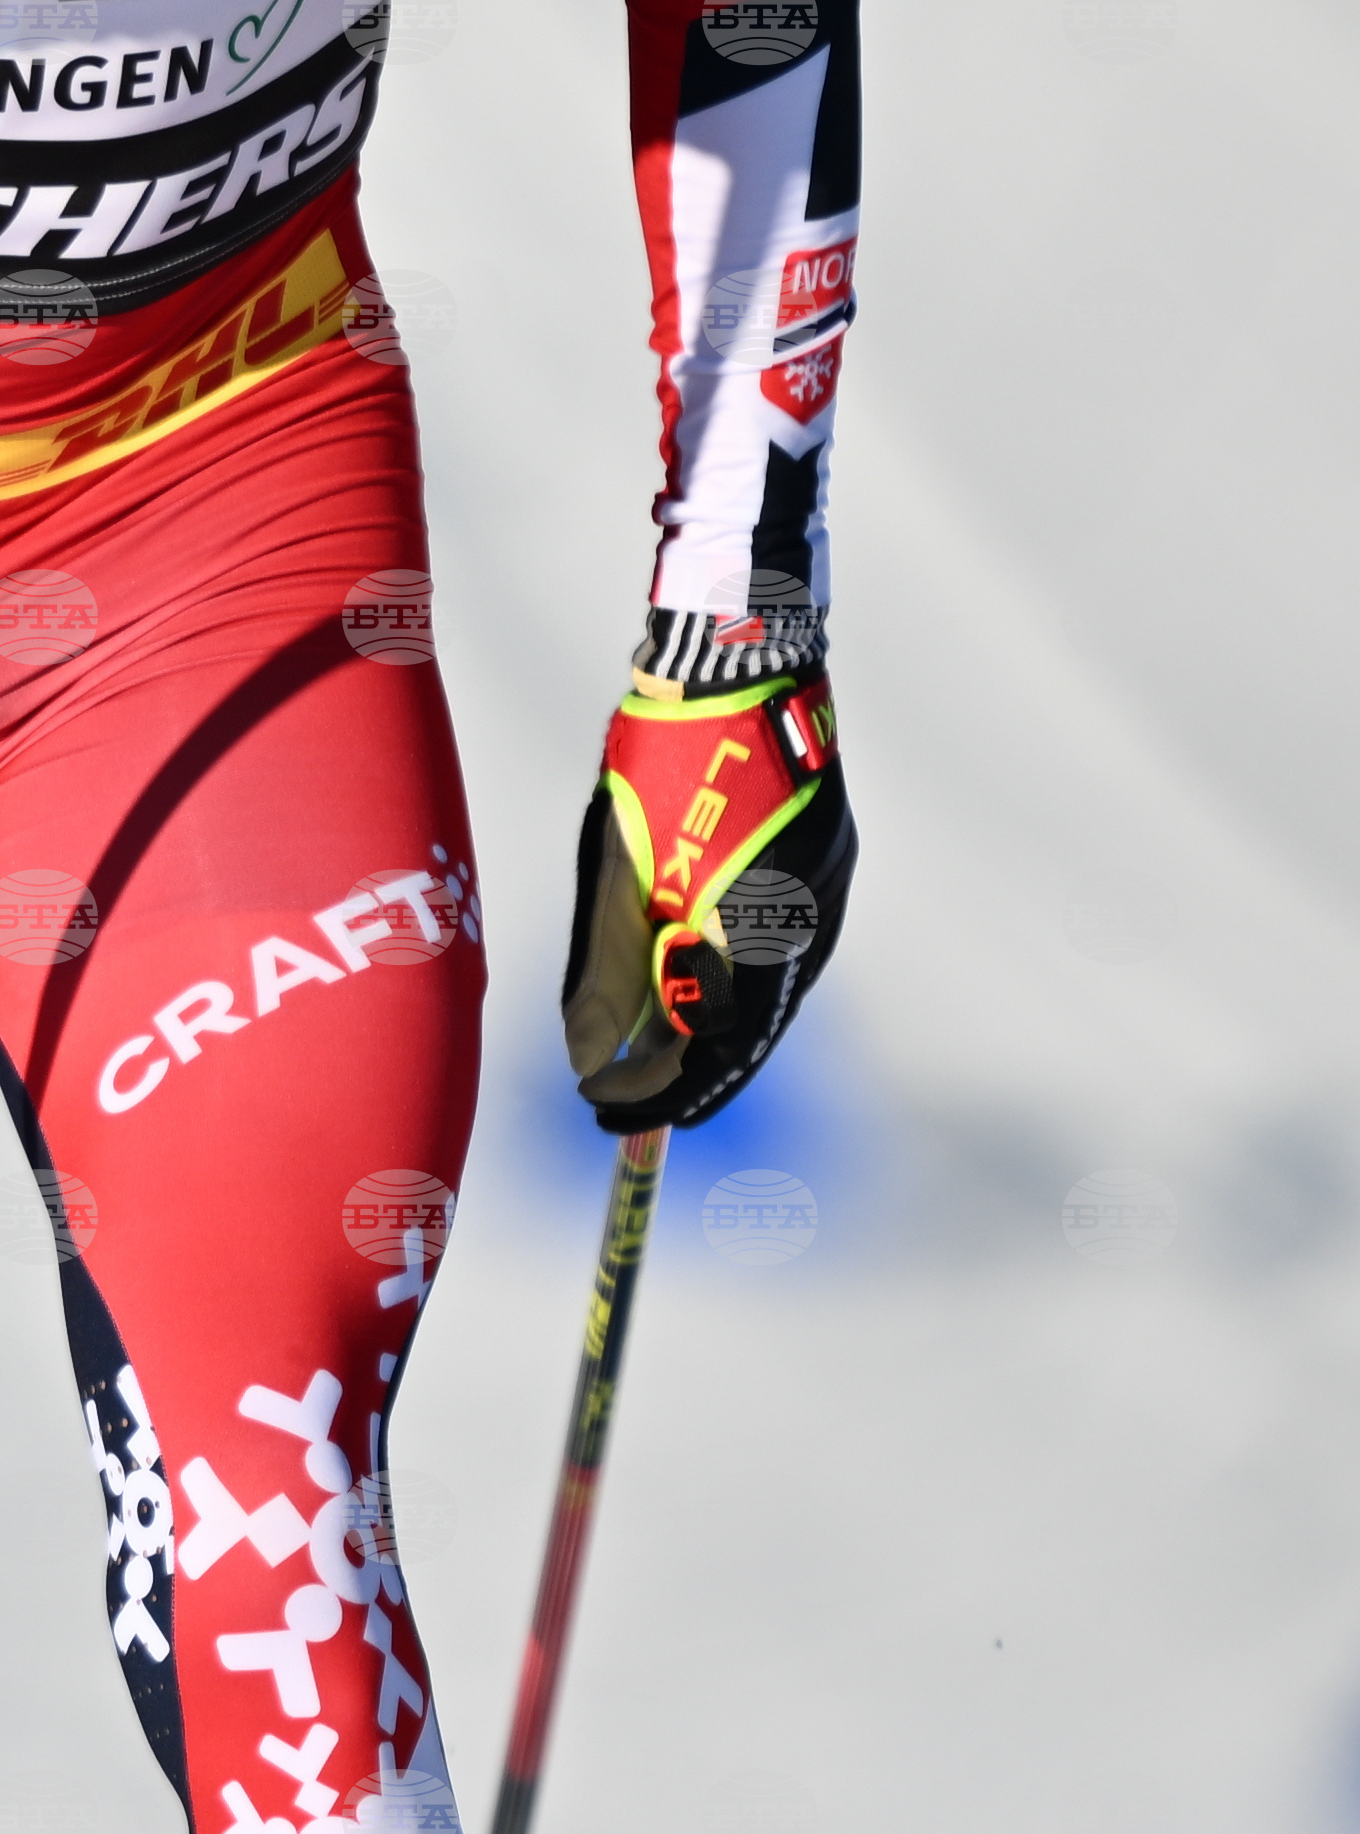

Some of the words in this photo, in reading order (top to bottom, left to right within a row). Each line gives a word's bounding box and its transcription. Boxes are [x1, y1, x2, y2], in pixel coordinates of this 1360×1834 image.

[45, 276, 317, 474] DHL
[654, 736, 752, 910] LEKI
[95, 869, 443, 1115] CRAFT
